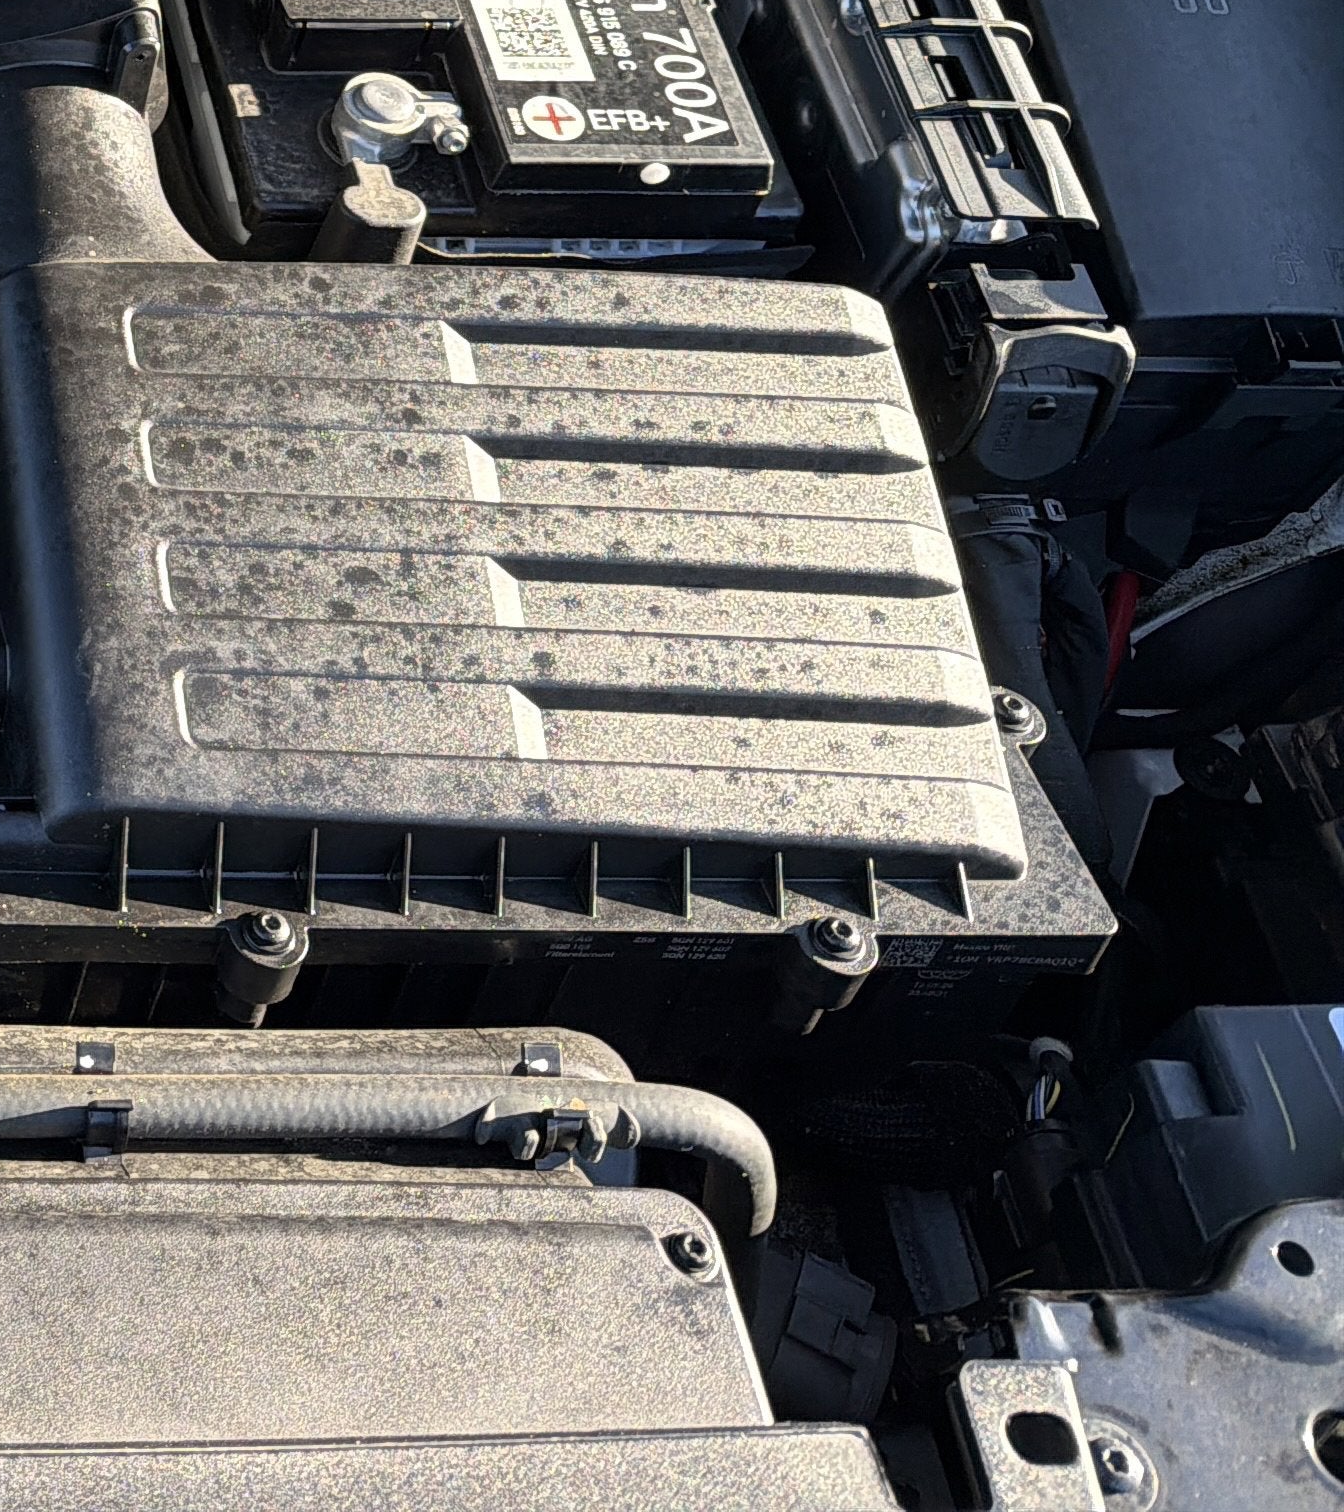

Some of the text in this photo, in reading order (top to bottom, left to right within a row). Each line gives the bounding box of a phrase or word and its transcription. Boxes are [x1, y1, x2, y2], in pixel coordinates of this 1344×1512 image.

[596, 7, 622, 27] 915
[616, 59, 639, 70] C
[643, 28, 730, 144] 700A
[584, 108, 673, 131] EFB+
